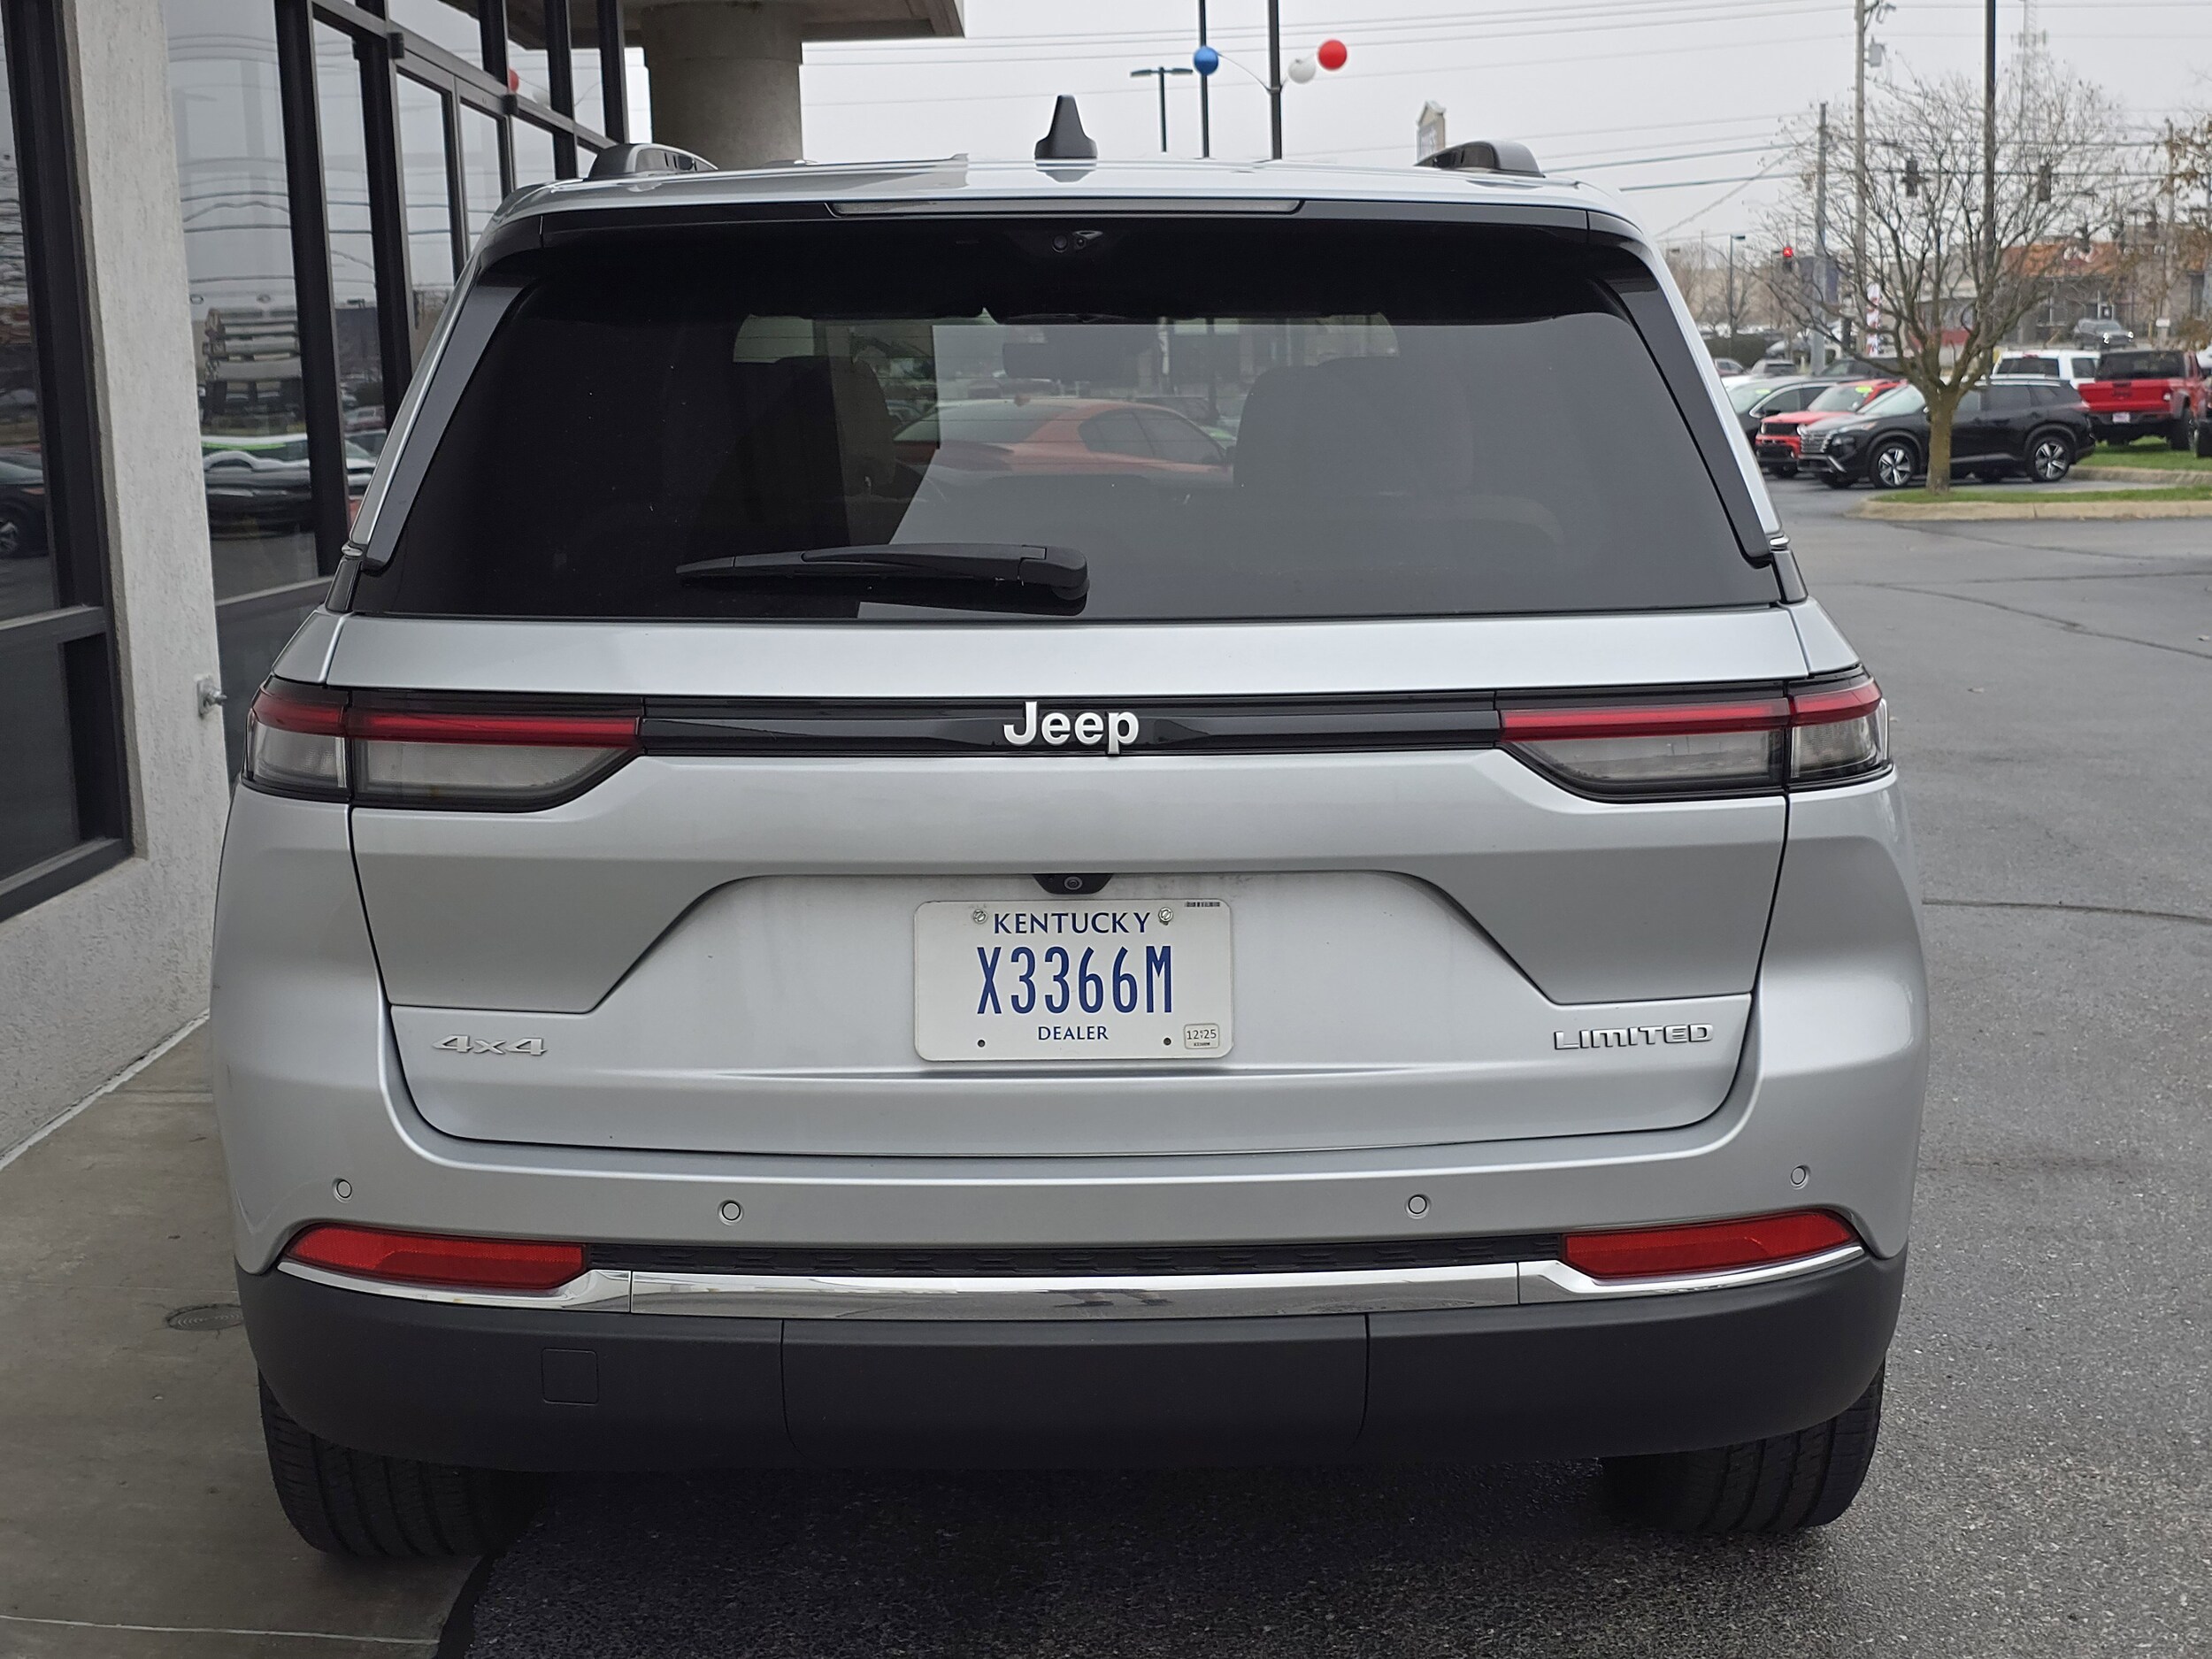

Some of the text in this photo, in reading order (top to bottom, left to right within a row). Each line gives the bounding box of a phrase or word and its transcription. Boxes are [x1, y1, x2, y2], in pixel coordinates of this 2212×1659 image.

[1003, 701, 1139, 755] Jeep
[995, 912, 1150, 933] KENTUCKY
[977, 945, 1172, 1014] X3366M
[1038, 1025, 1109, 1040] DEALER
[1555, 1023, 1713, 1050] LIMITED
[432, 1034, 548, 1056] 4x4
